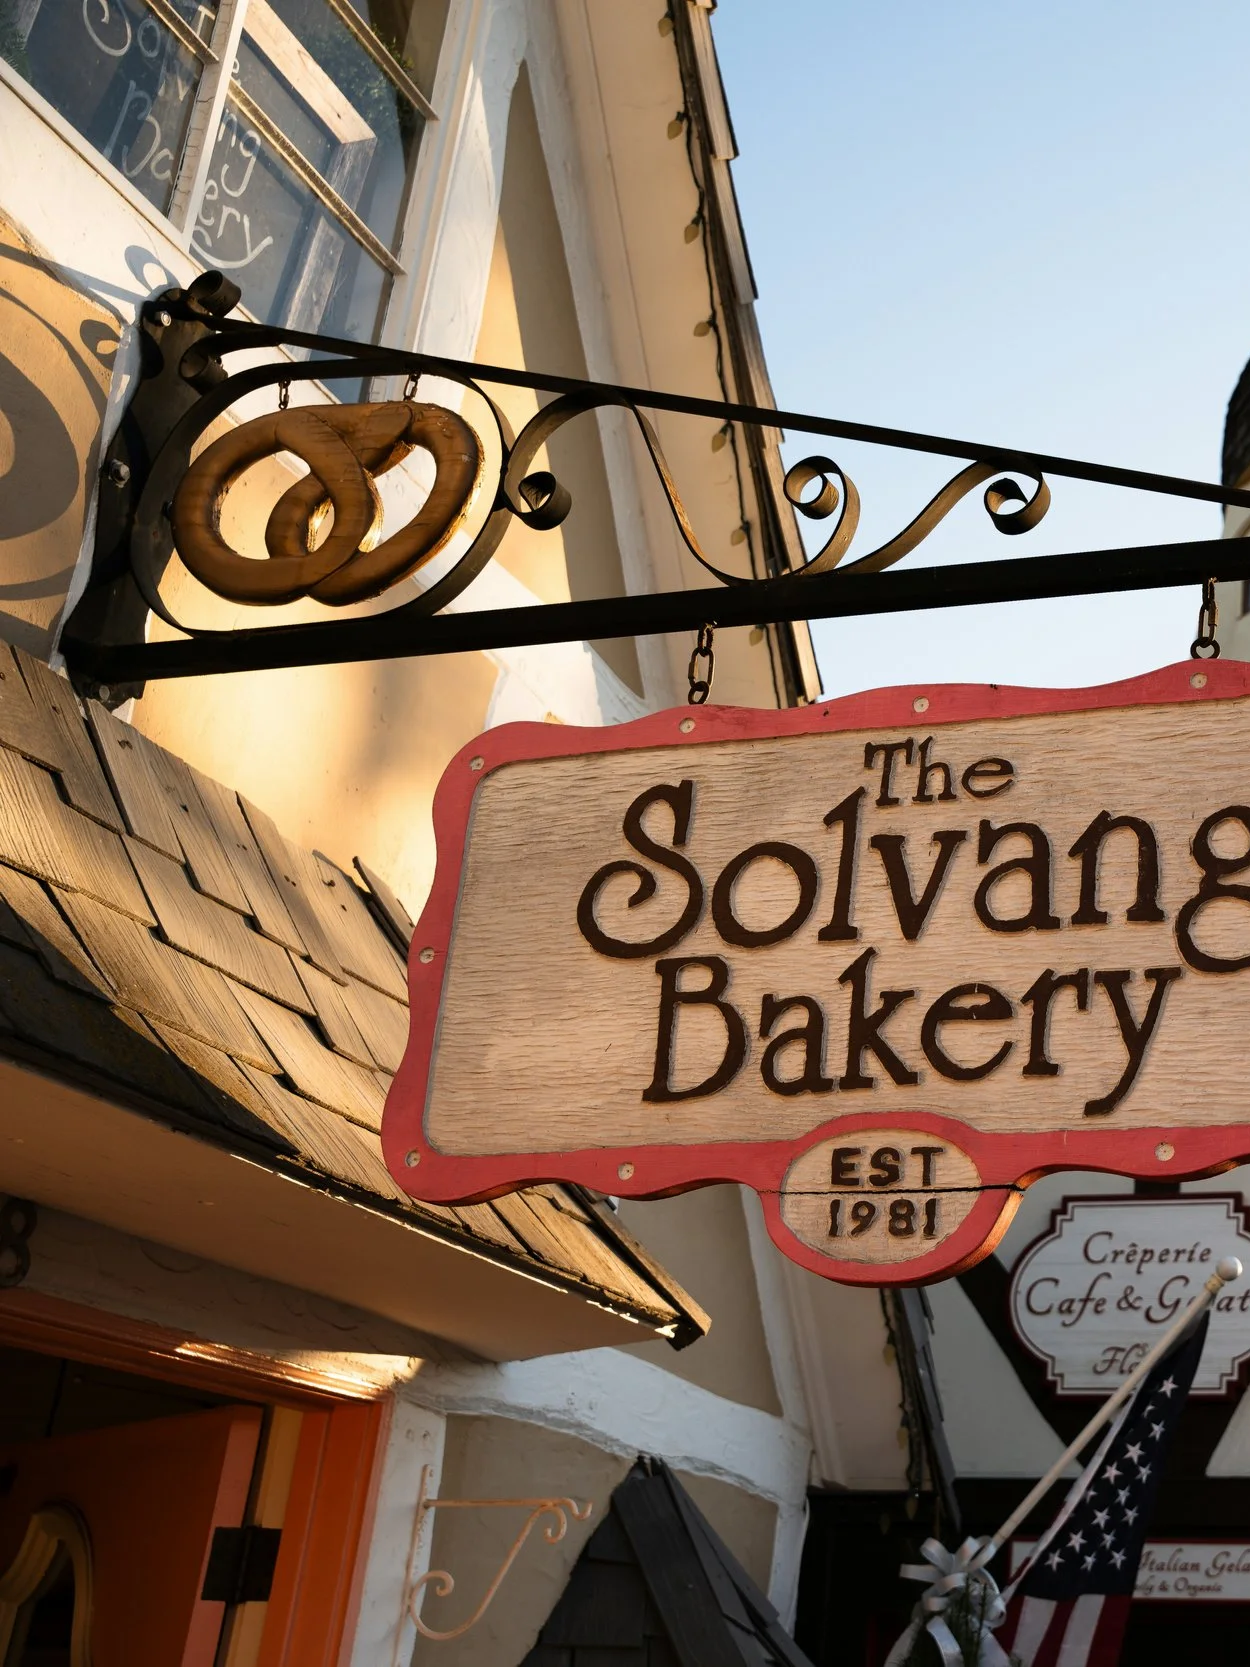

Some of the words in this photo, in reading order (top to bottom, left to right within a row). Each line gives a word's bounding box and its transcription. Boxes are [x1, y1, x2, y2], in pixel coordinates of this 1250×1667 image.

[103, 79, 273, 268] Baery
[864, 736, 1015, 808] The
[641, 946, 1184, 1118] Bakery
[830, 1146, 944, 1187] EST
[828, 1198, 938, 1240] 1981
[1082, 1231, 1212, 1275] Crêperie
[1026, 1271, 1112, 1328] Cafe
[1116, 1285, 1143, 1312] &
[1138, 1548, 1201, 1574] Italian
